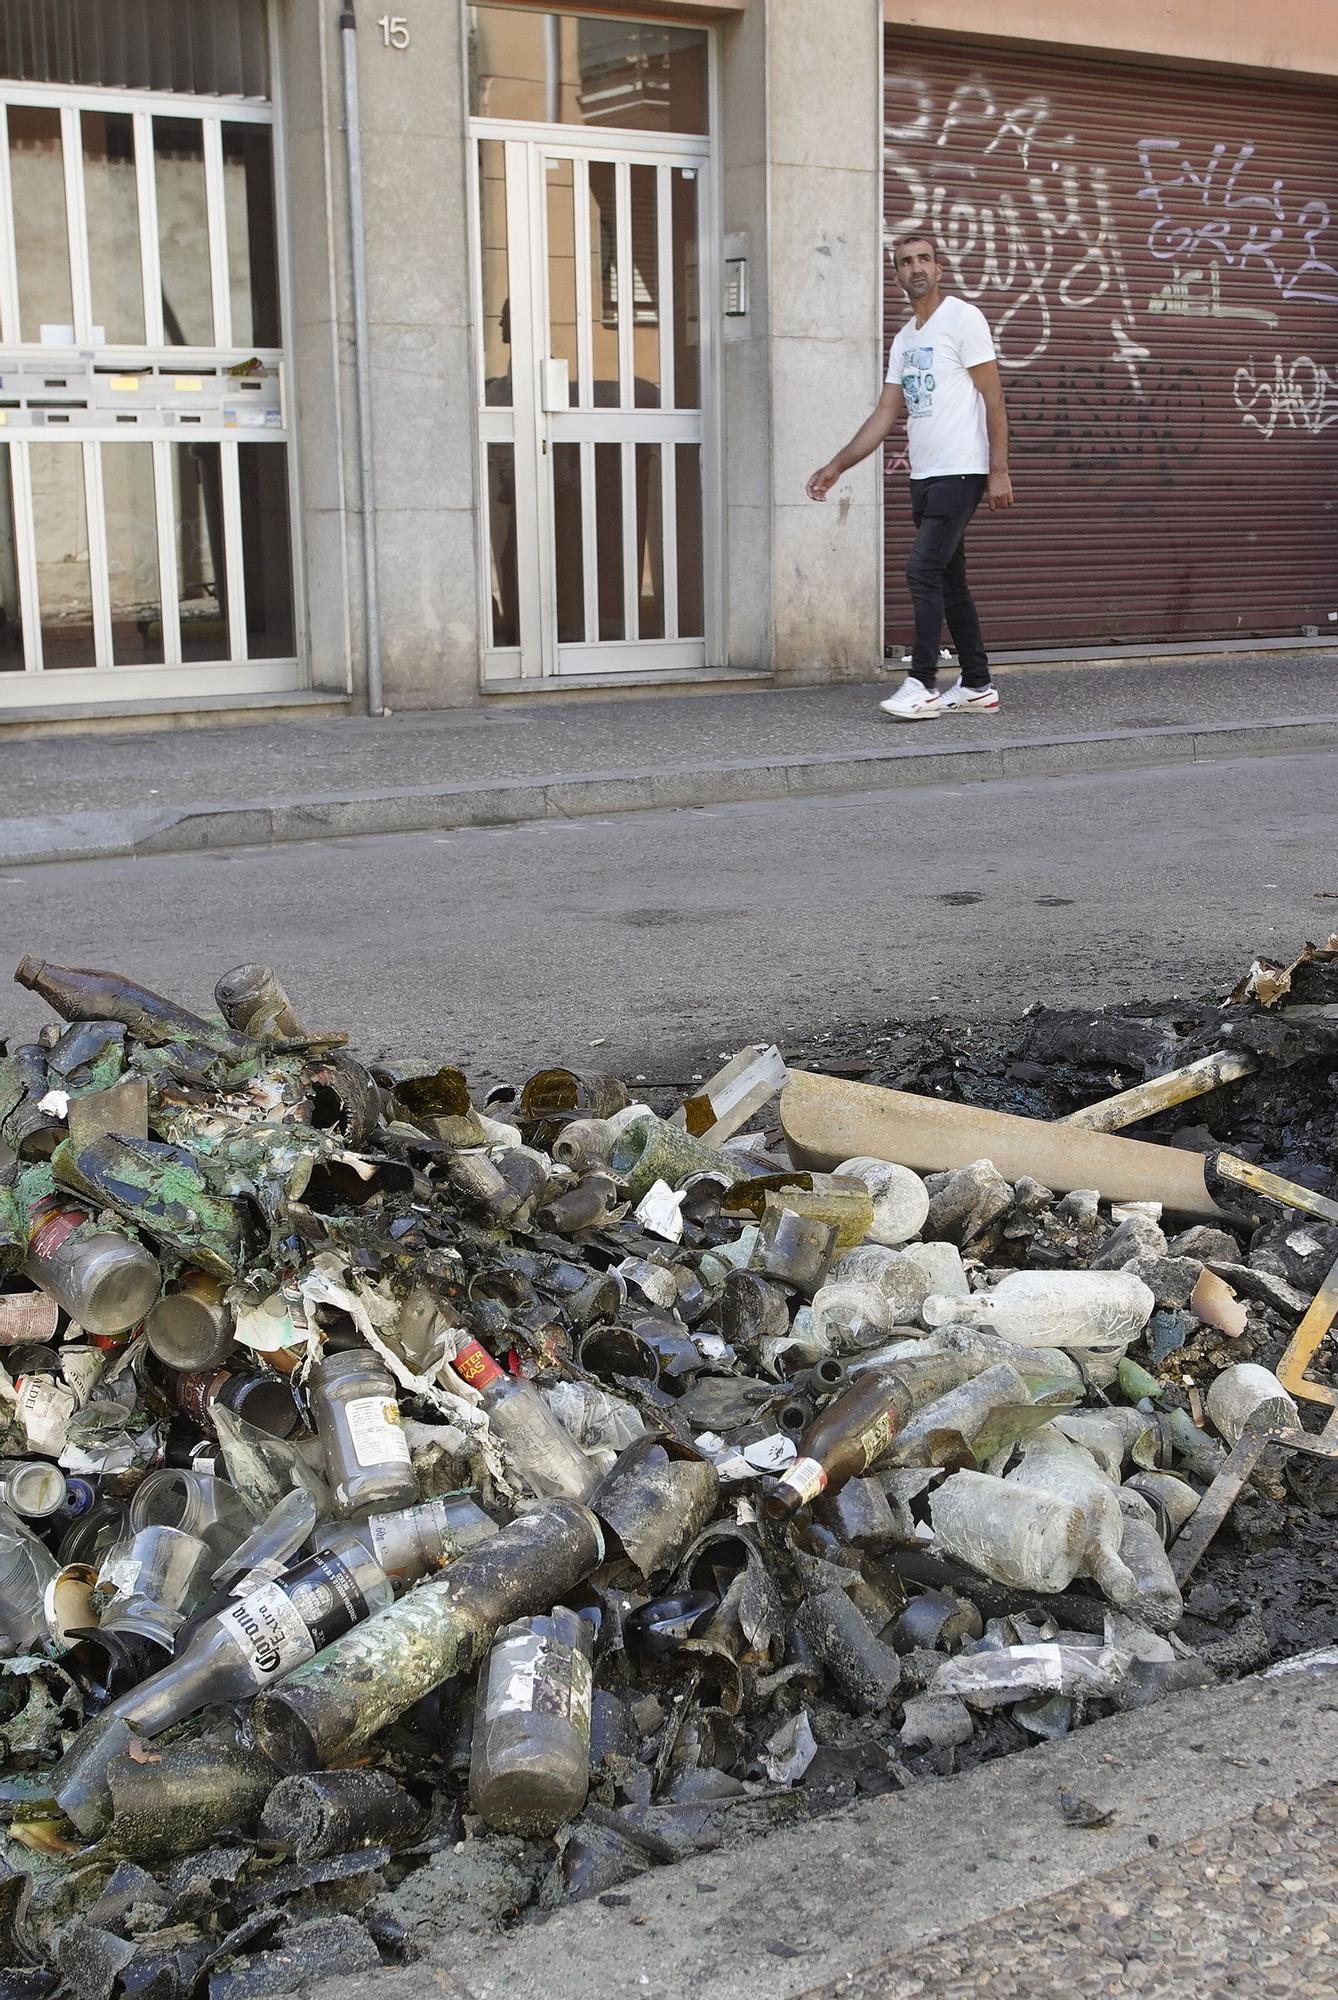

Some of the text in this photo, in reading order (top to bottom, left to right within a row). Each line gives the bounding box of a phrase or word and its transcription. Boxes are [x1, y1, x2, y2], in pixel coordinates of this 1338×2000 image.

[377, 15, 410, 49] 15
[463, 1361, 486, 1380] KAS
[232, 1605, 281, 1673] Corona
[259, 1604, 286, 1646] Extra
